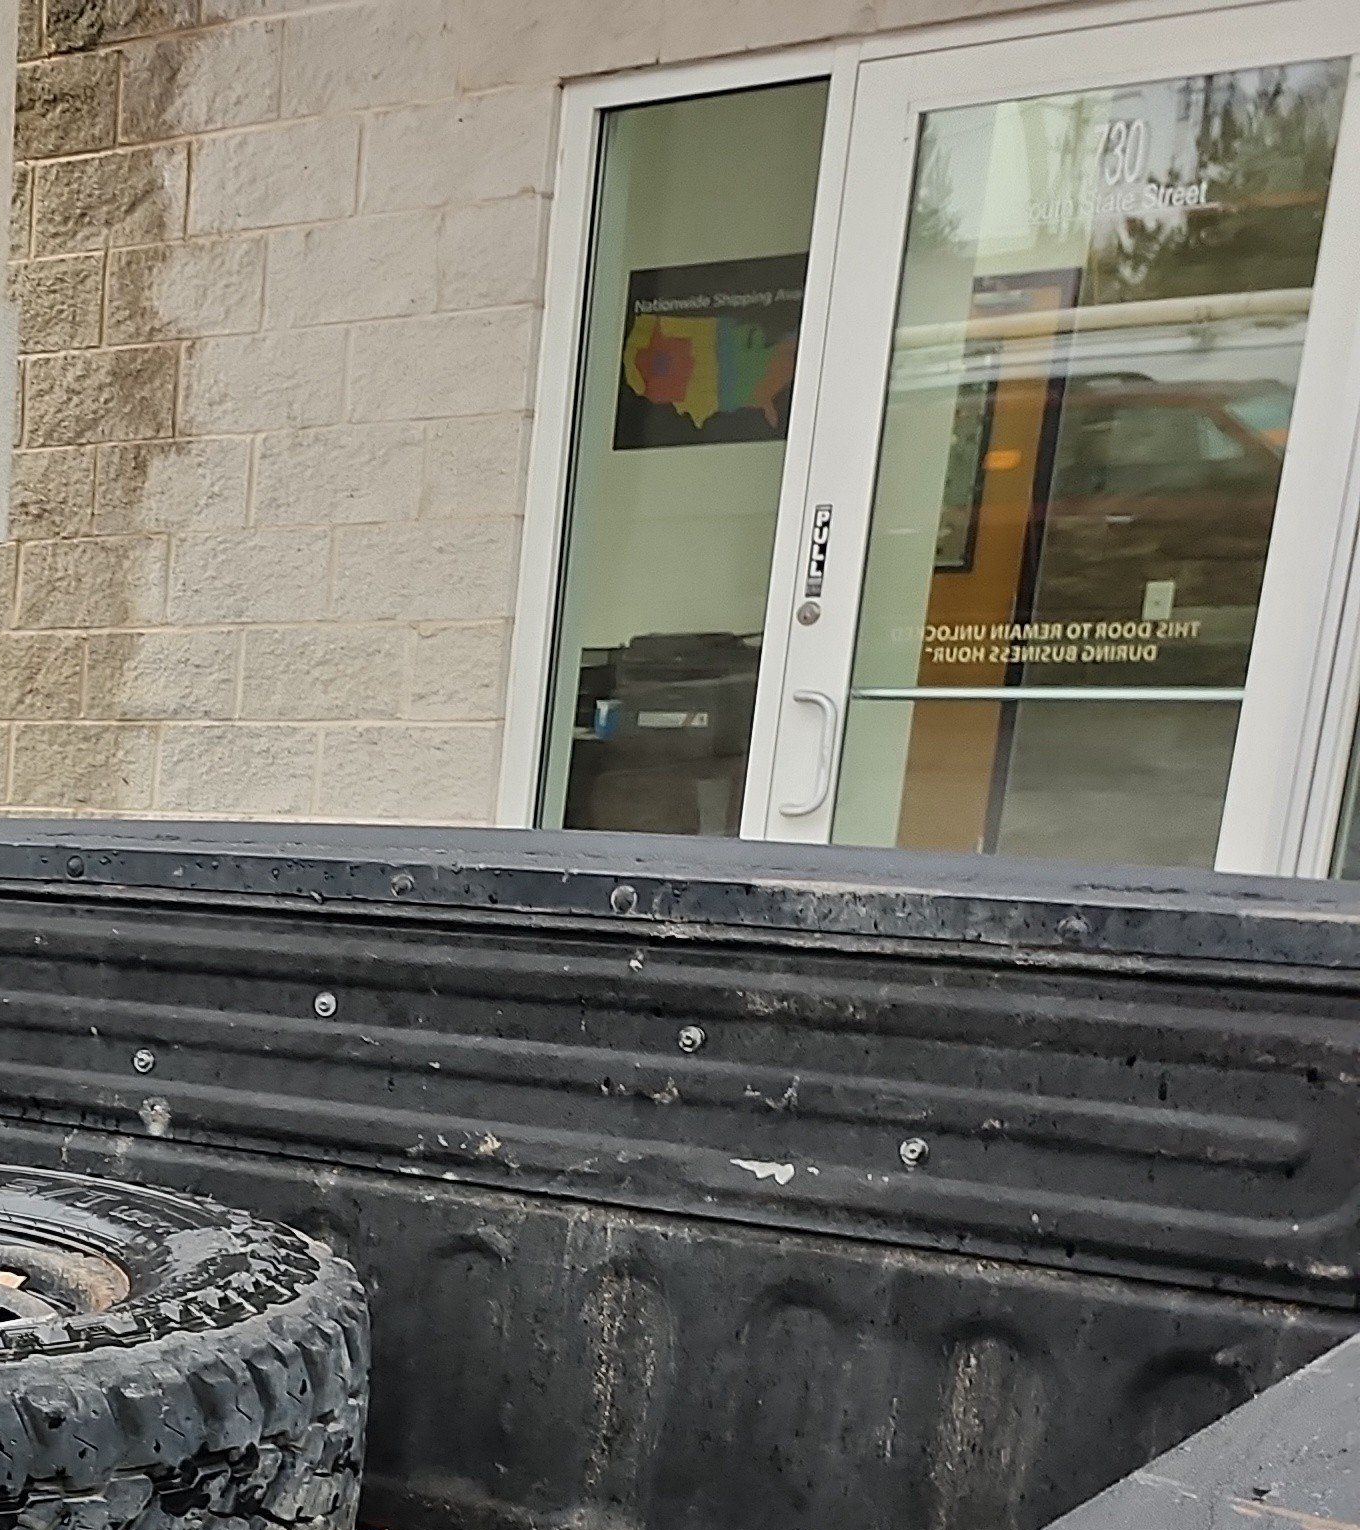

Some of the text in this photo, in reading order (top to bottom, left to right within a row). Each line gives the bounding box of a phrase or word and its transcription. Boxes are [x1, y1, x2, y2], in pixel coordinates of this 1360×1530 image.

[1095, 118, 1145, 186] 730
[1142, 180, 1209, 210] Street
[634, 295, 711, 314] Nationwide
[809, 509, 831, 578] PULL
